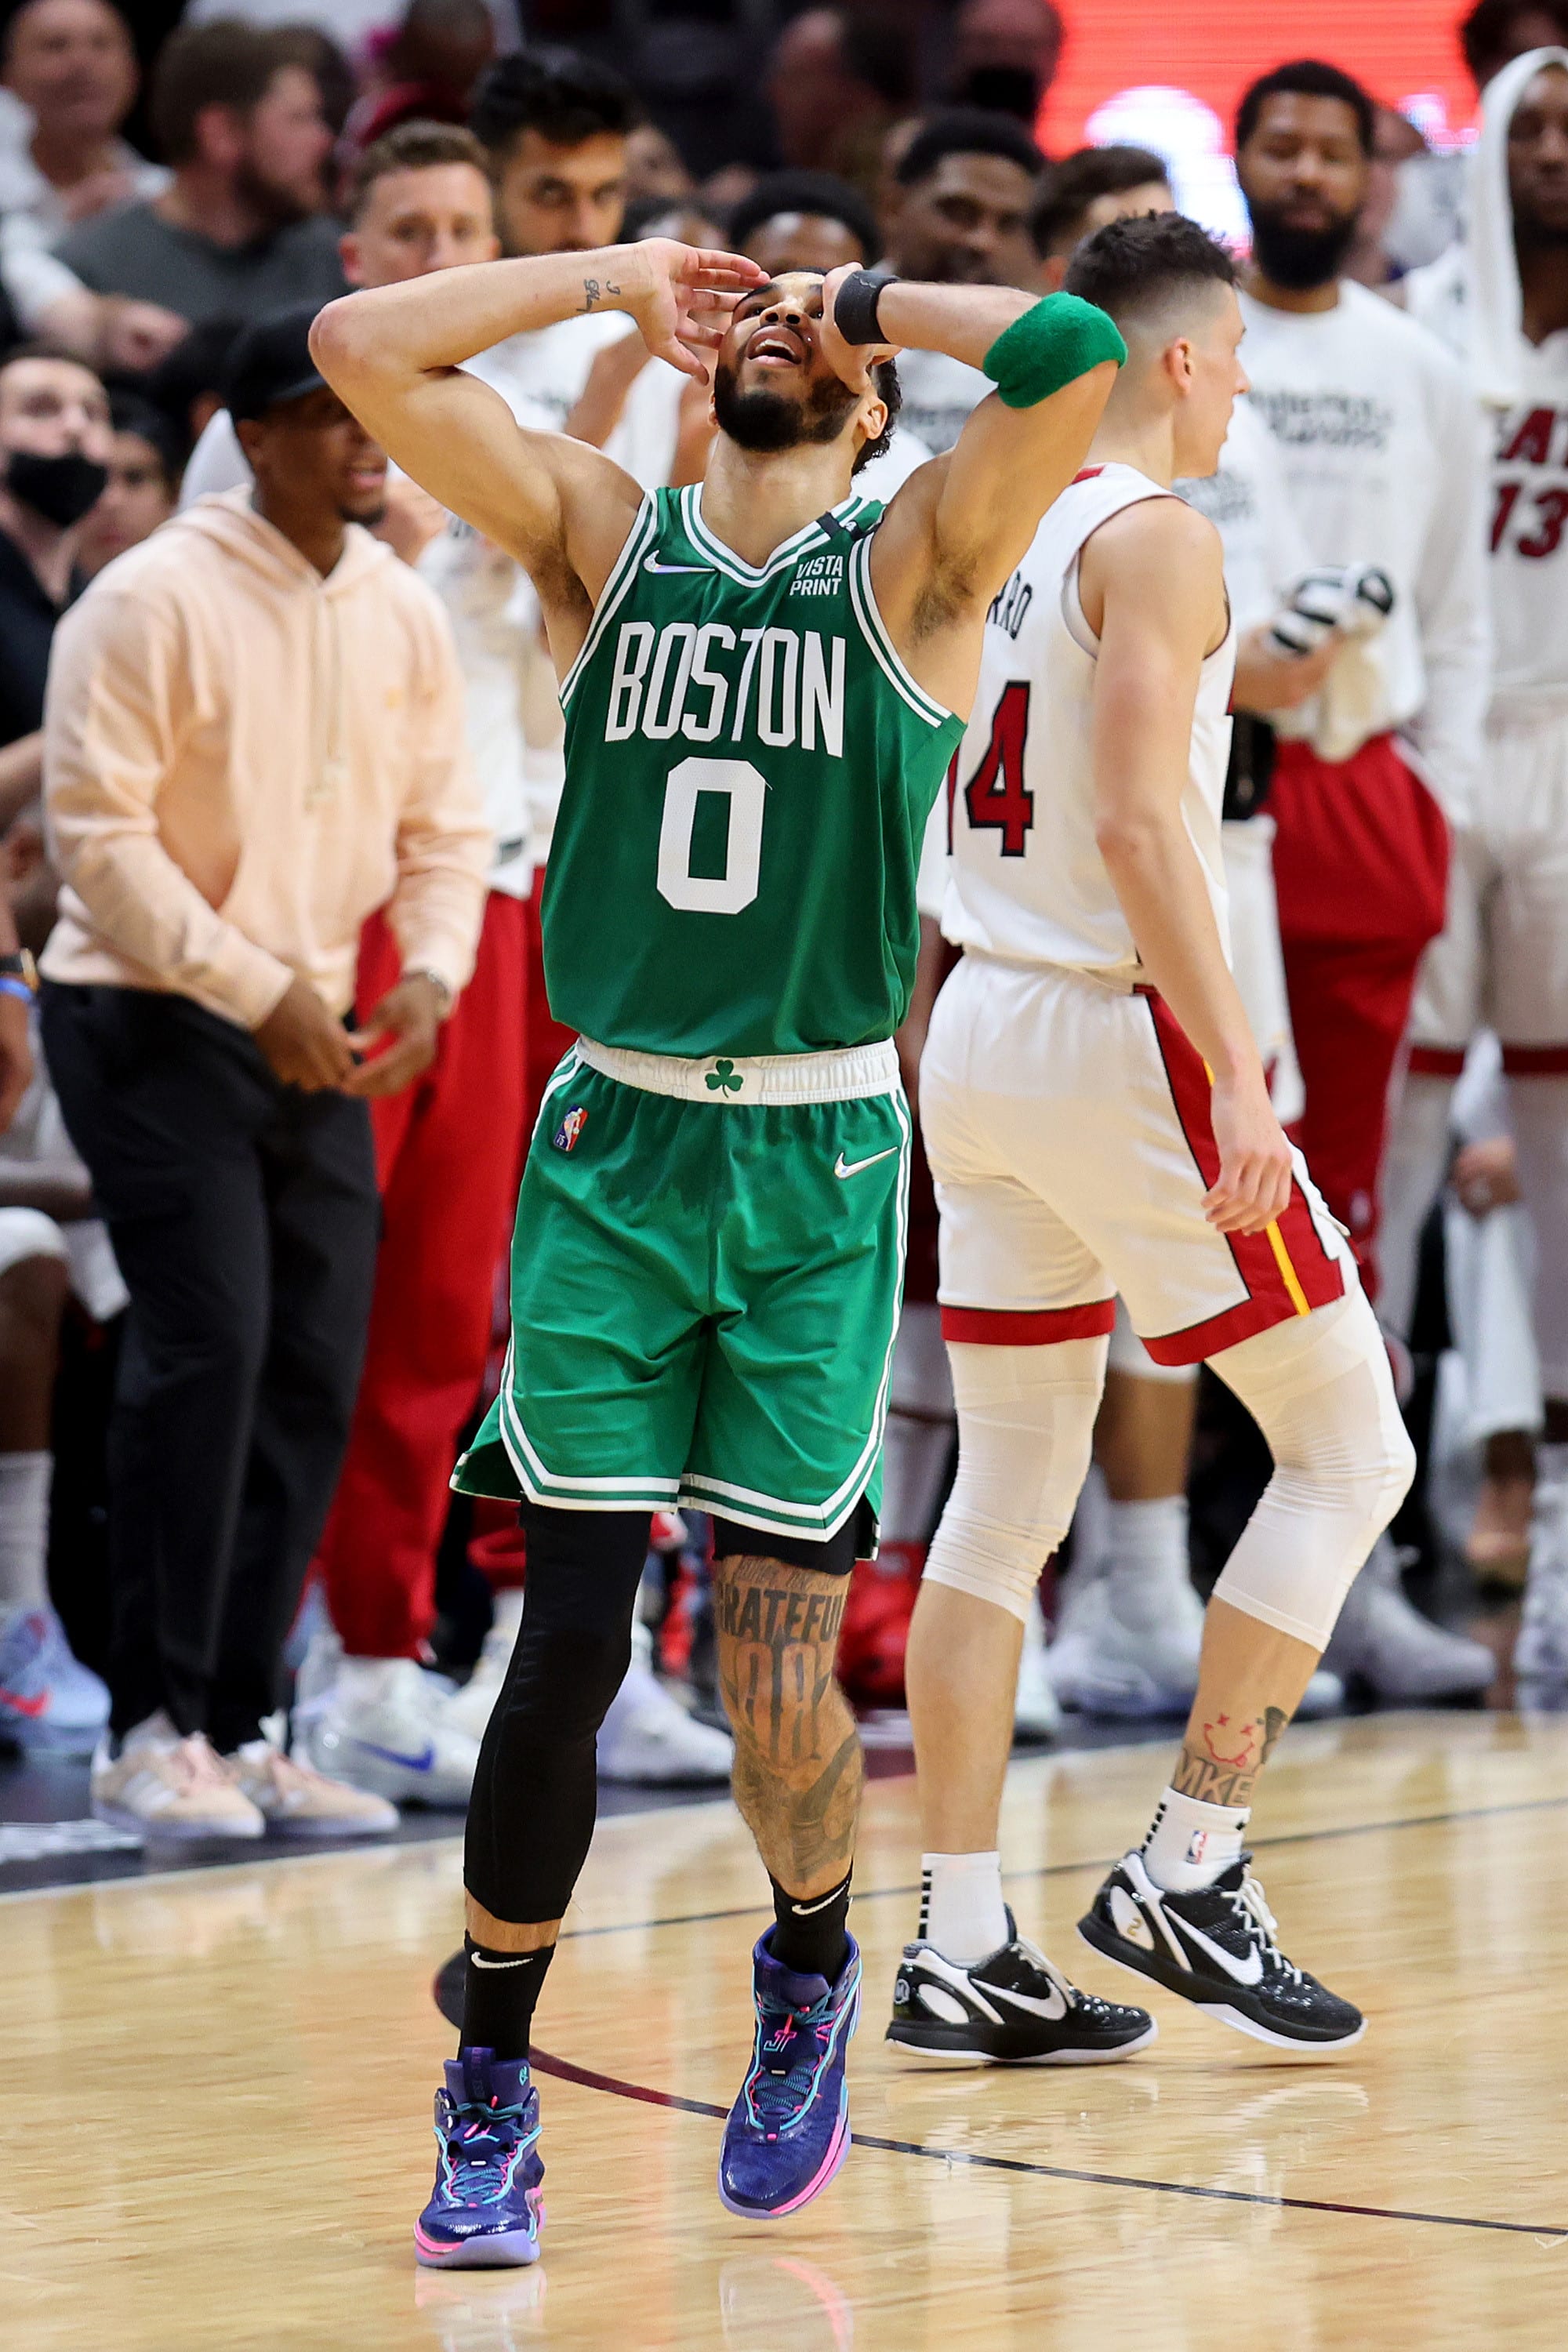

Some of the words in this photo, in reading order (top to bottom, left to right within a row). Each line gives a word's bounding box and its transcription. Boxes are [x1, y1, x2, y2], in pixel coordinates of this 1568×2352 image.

[1490, 481, 1568, 558] 13
[789, 577, 842, 596] PRINT
[796, 555, 844, 579] VISTA
[604, 621, 846, 758] BOSTON
[657, 756, 767, 915] 0
